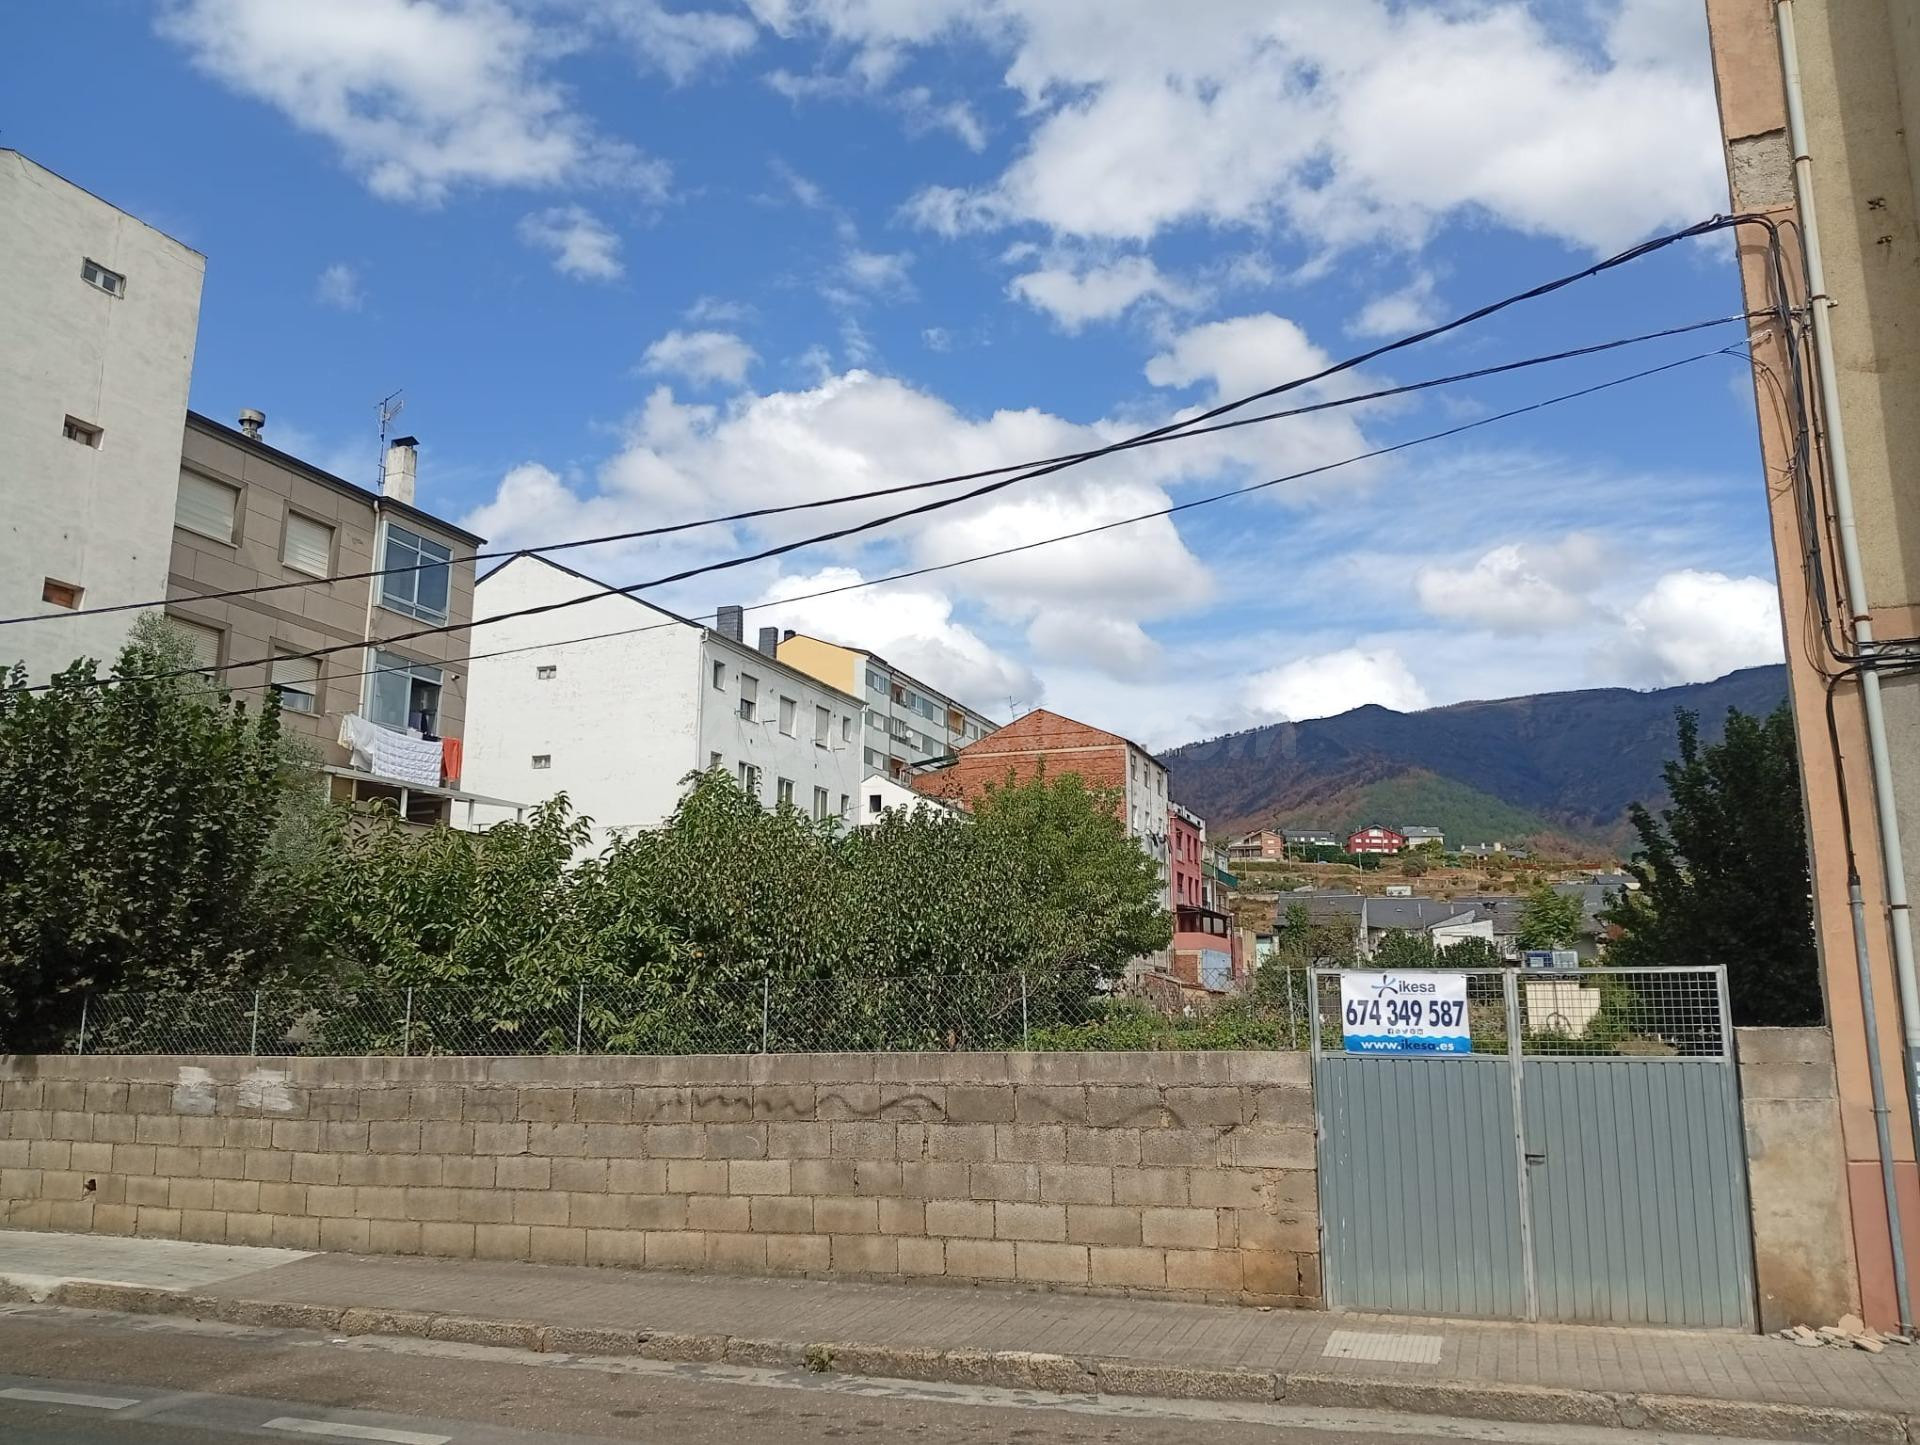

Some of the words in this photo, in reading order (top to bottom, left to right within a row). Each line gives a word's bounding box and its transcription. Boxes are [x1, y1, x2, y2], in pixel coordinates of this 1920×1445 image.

[1398, 981, 1436, 993] ikesa
[1346, 999, 1381, 1026] 674
[1386, 1000, 1422, 1026] 349
[1429, 1000, 1464, 1027] 587
[1360, 1039, 1455, 1051] www.ikesa.es
